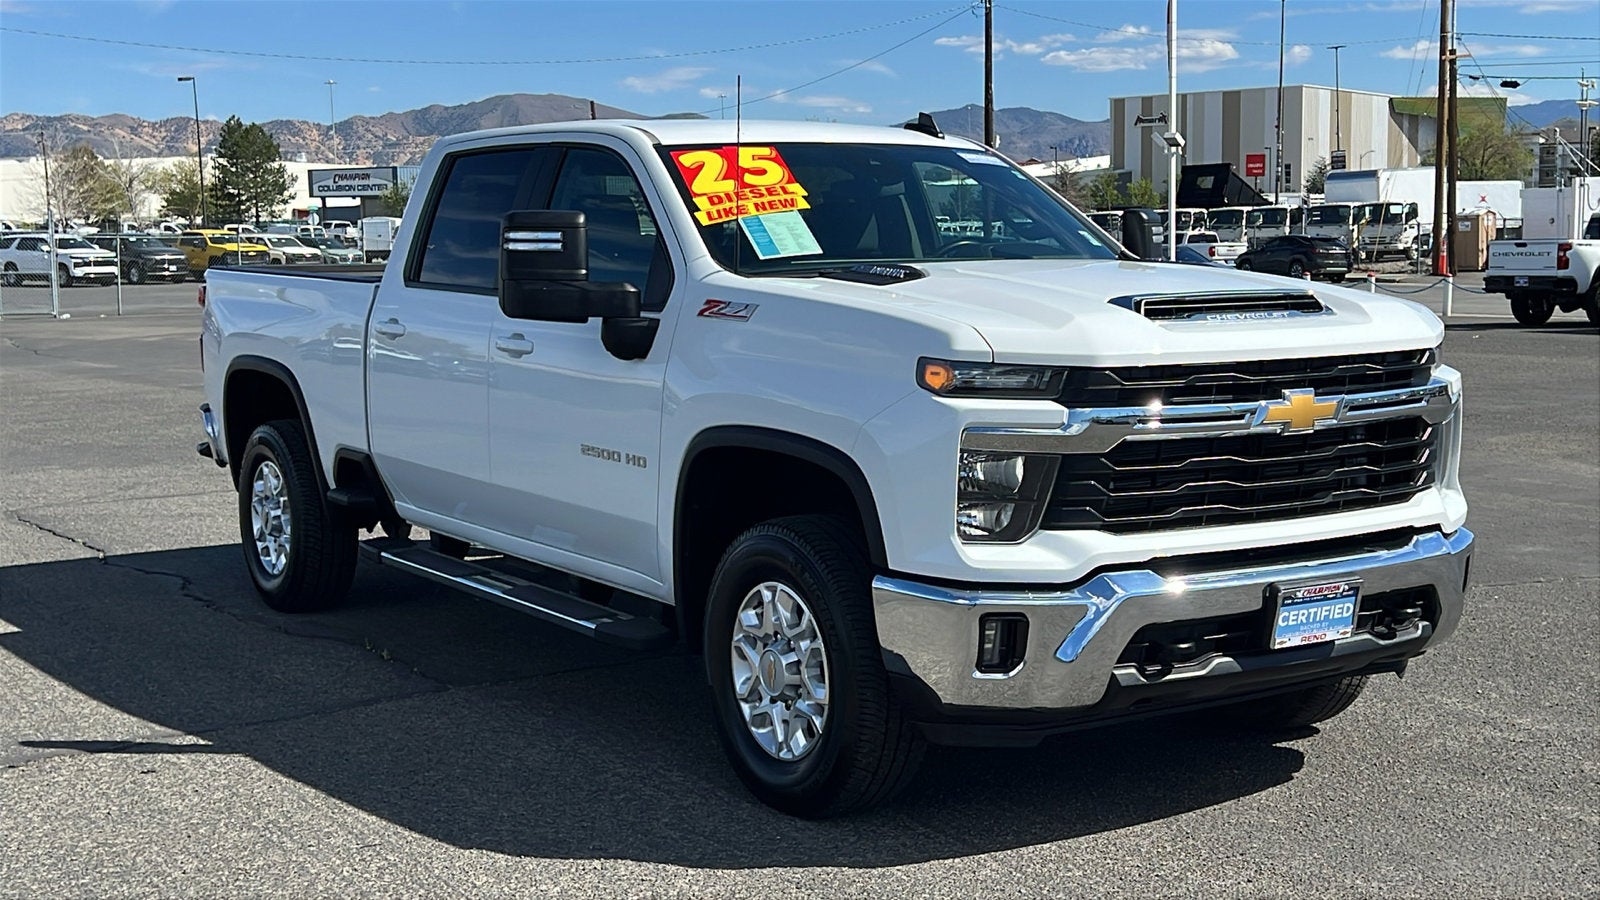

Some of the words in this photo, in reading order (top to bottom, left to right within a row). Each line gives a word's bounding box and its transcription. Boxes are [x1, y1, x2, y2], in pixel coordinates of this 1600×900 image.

[333, 173, 371, 184] CHAMPION
[678, 146, 787, 195] 25
[318, 184, 356, 192] COLLISION
[357, 184, 387, 192] CENTER
[706, 185, 797, 207] DIESEL
[705, 205, 750, 222] LIKE
[754, 197, 798, 213] NEW
[1206, 311, 1290, 321] CHEVROLET
[580, 443, 622, 463] 2500
[625, 453, 647, 469] HD
[1302, 585, 1341, 596] CHAMPION
[1279, 603, 1353, 626] CERTIFIED
[1301, 634, 1326, 643] RENO
